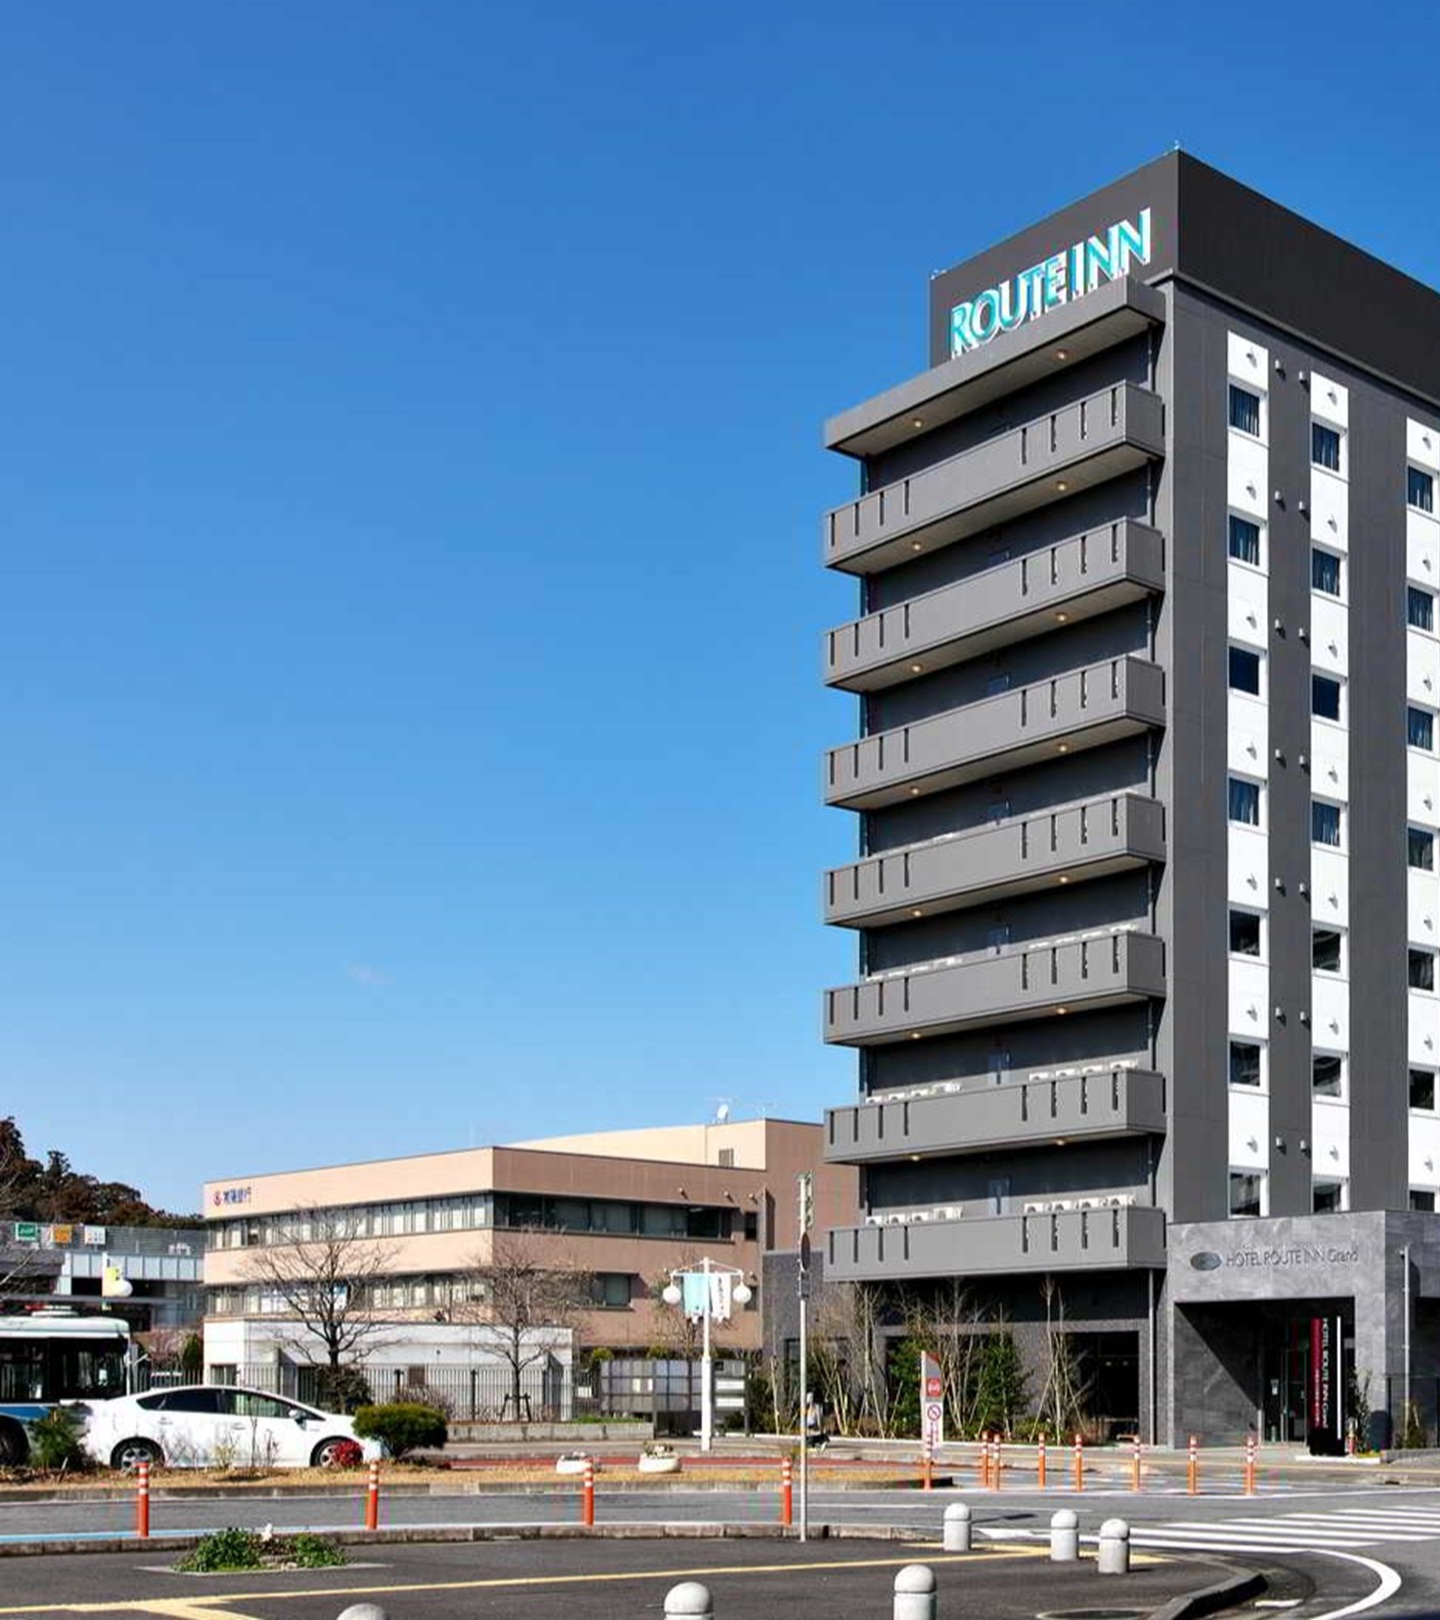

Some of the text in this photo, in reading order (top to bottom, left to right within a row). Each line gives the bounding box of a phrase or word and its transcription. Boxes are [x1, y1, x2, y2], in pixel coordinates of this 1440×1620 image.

[950, 207, 1151, 360] ROUTE INN
[1227, 1247, 1359, 1267] HOTEL ROUTE INN Grand
